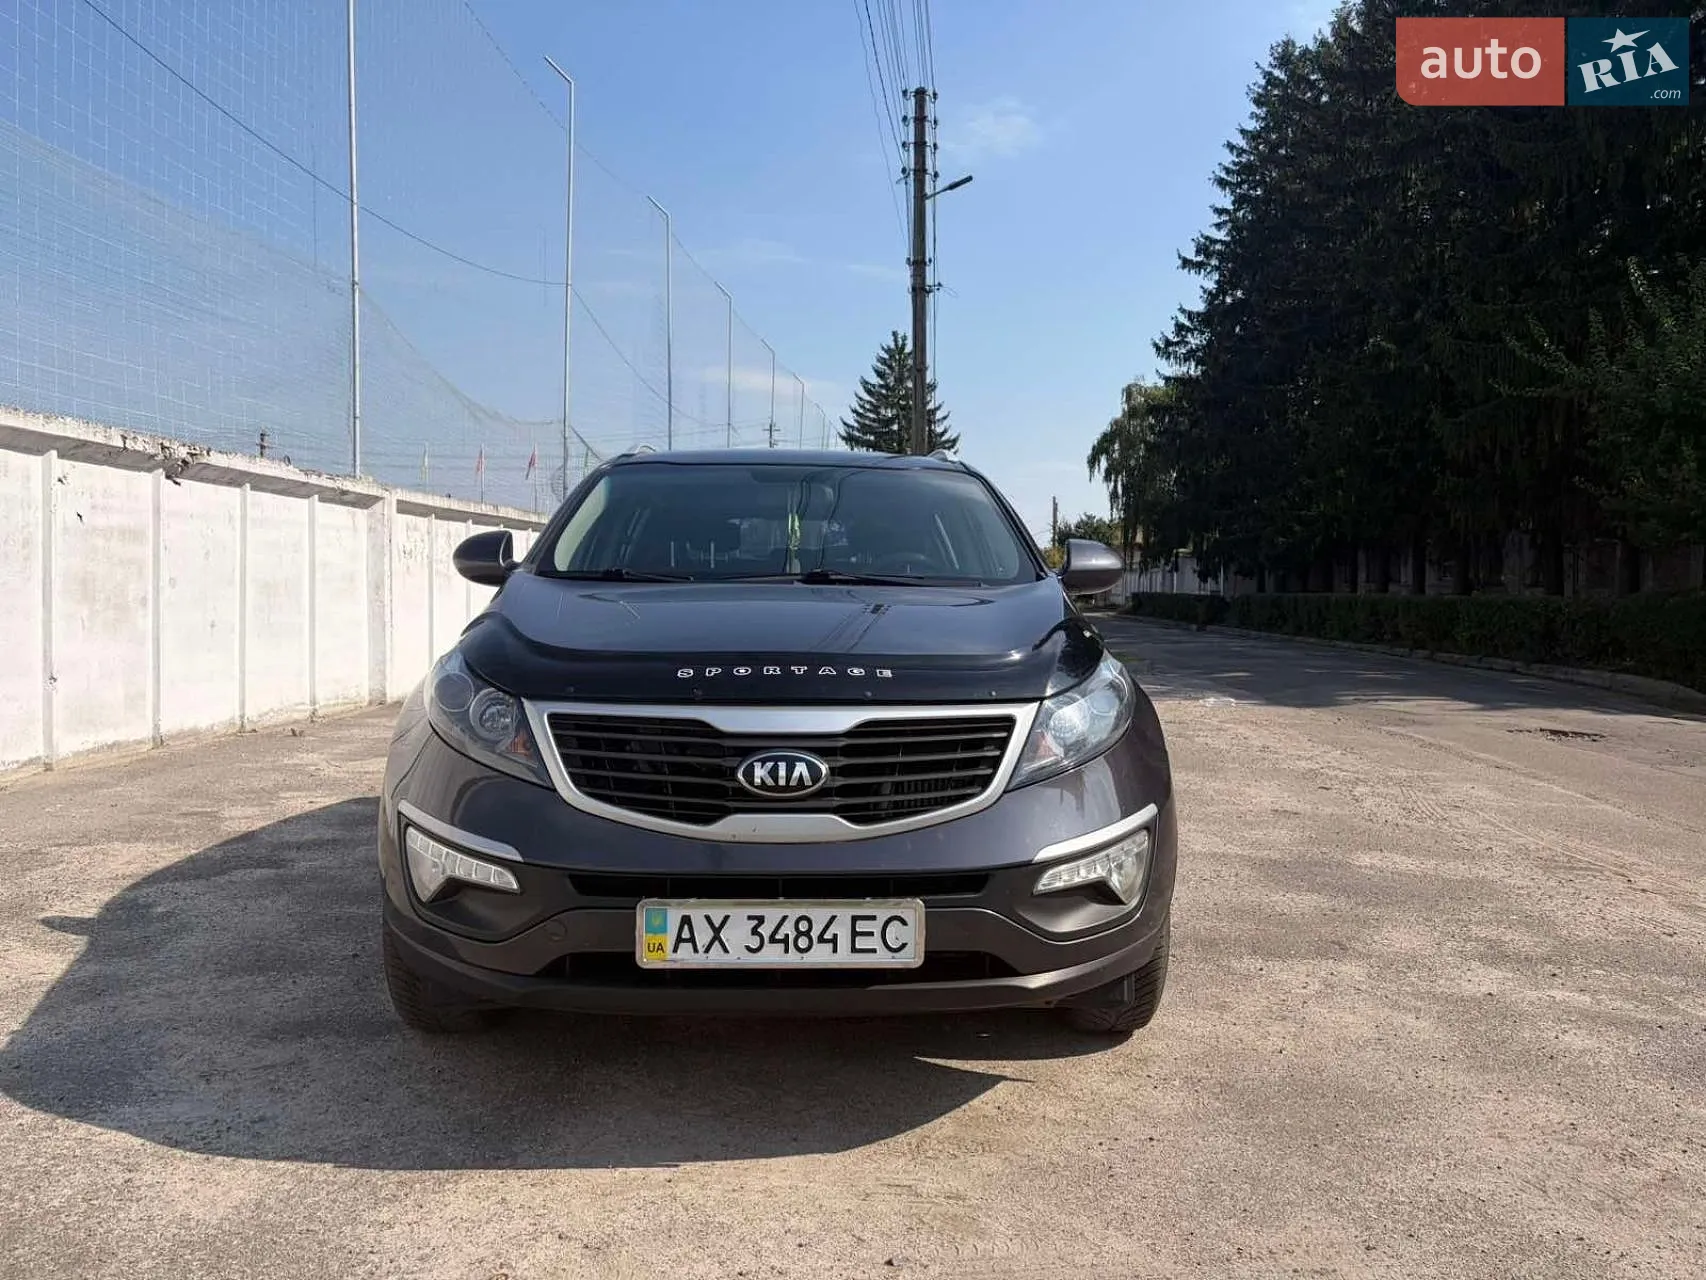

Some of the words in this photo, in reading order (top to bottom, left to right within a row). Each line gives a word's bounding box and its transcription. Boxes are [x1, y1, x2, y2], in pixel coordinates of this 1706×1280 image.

[677, 666, 893, 678] SPORTAGE
[753, 761, 813, 786] KIA
[672, 914, 731, 954] AX
[744, 914, 839, 954] 3484
[850, 914, 909, 954] EC
[647, 942, 665, 954] UA
